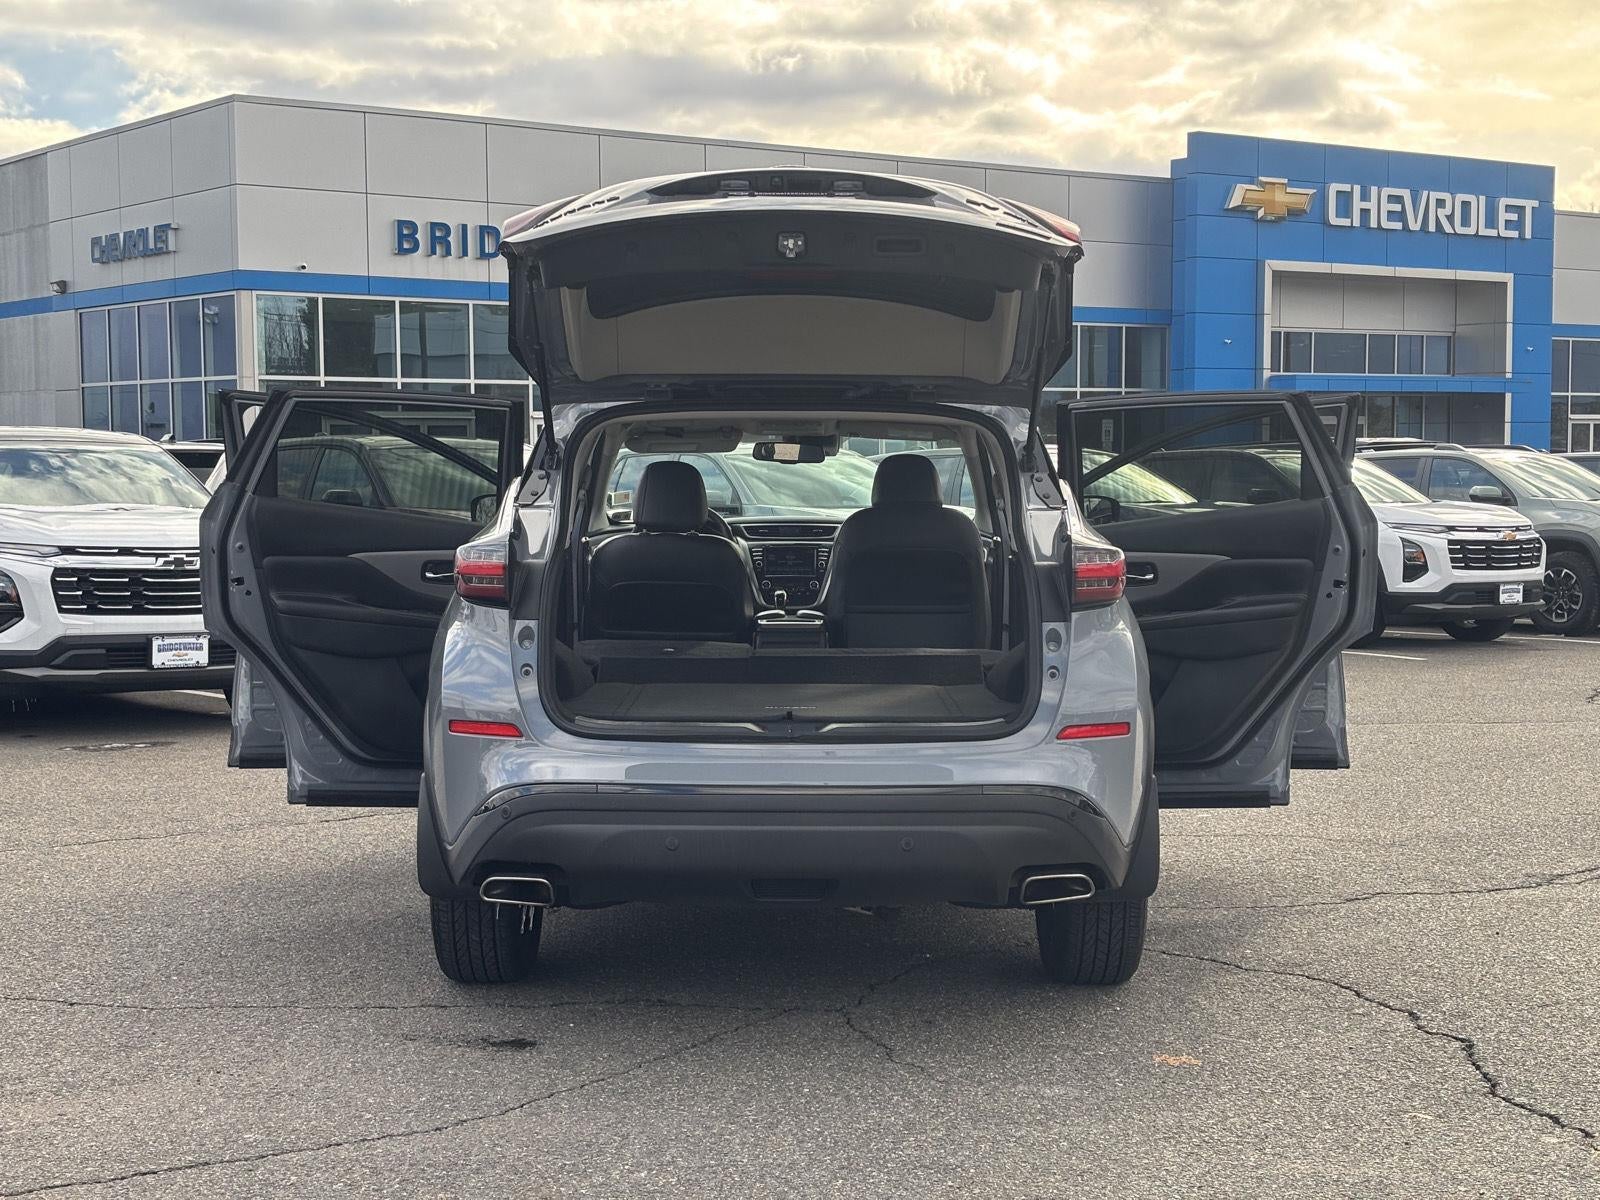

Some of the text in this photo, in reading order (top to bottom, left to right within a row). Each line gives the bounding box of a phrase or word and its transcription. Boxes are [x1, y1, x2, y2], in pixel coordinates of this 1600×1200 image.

[1328, 182, 1539, 239] CHEVROLET
[90, 223, 177, 264] CHEVROLET
[394, 219, 502, 260] BRID
[157, 642, 204, 653] BRIDGEWATER
